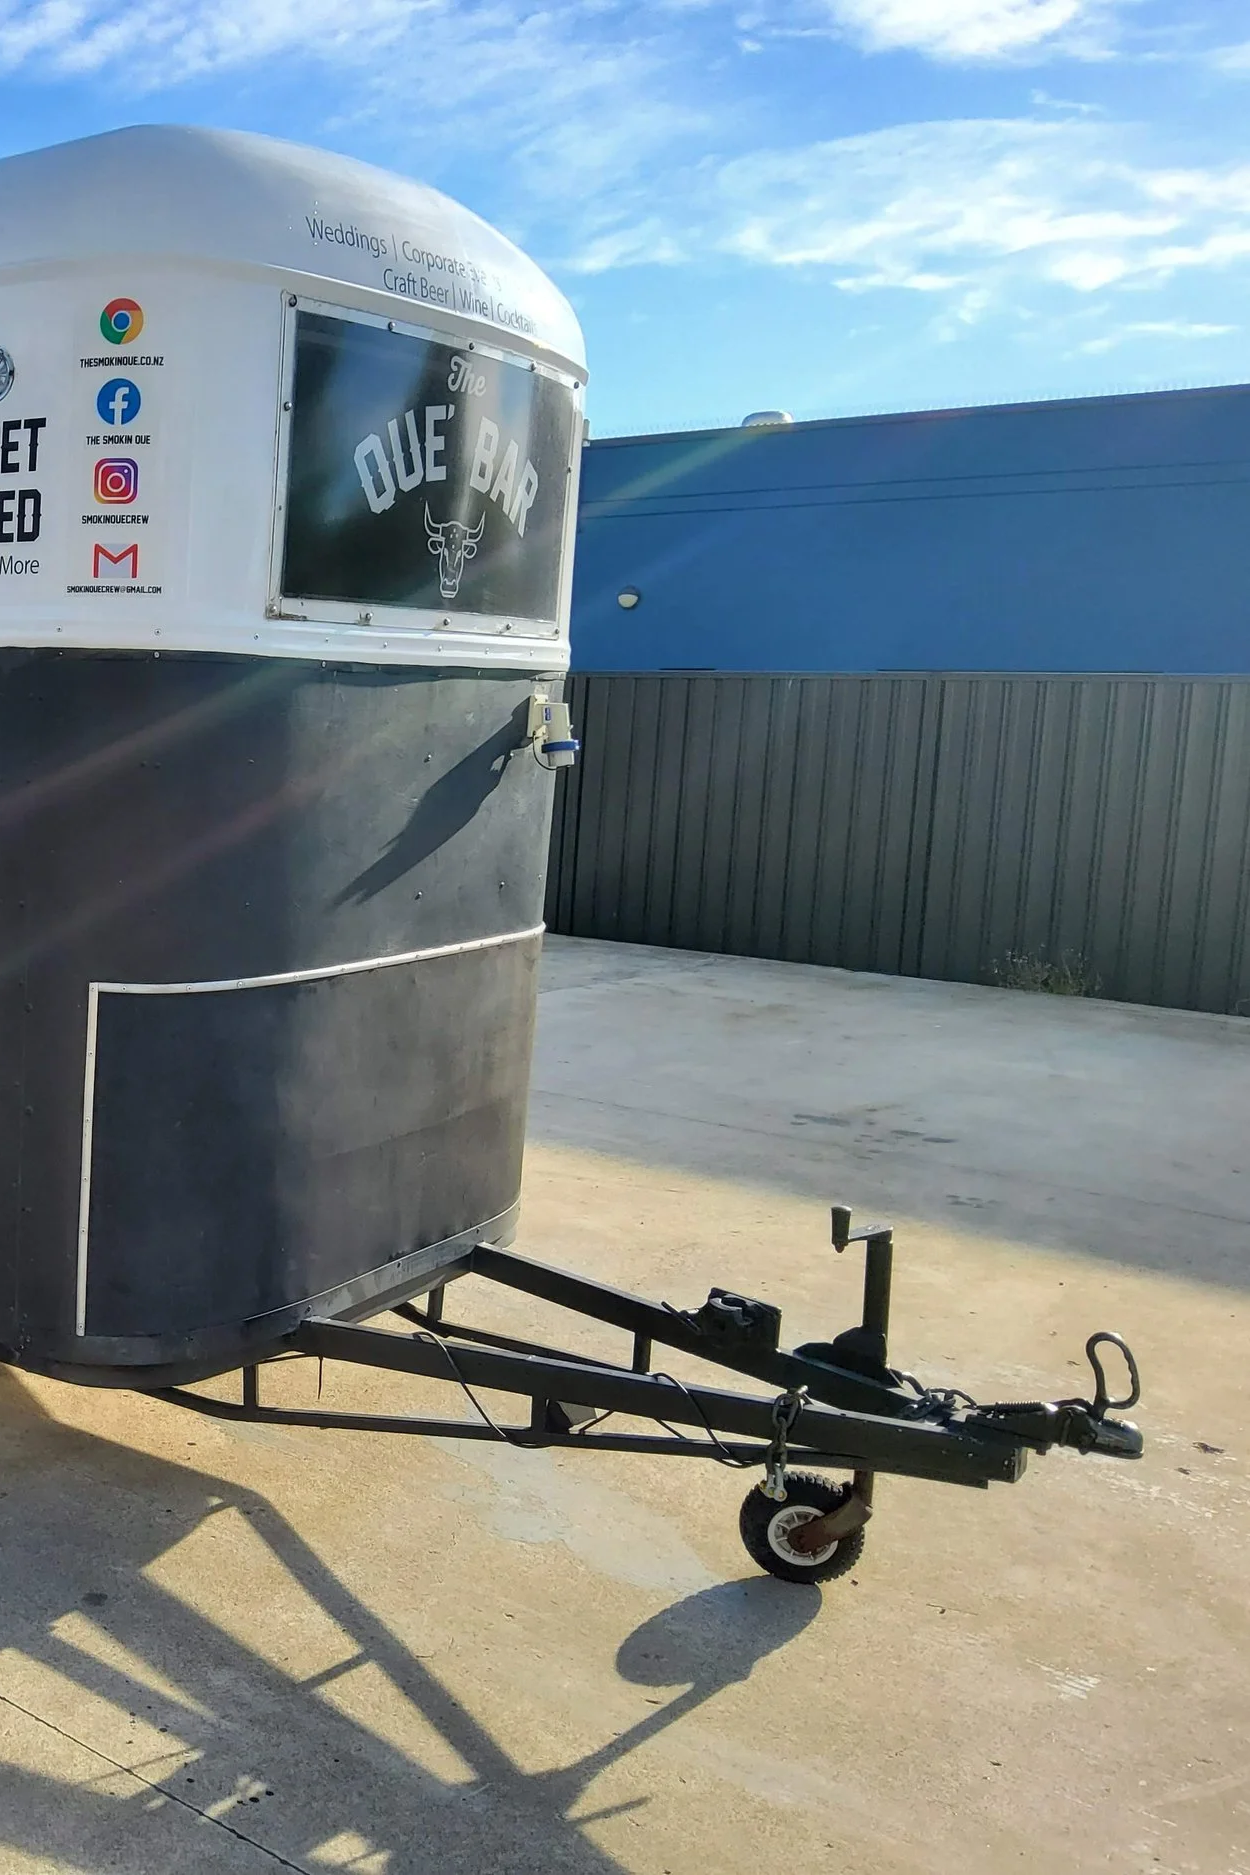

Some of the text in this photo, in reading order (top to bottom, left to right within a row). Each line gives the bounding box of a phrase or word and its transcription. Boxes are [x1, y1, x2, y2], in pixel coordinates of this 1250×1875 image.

[305, 216, 388, 258] Weddings
[401, 240, 465, 278] Corporate
[383, 268, 417, 296] Craft
[420, 276, 449, 303] Beer
[459, 287, 489, 317] Wine
[447, 355, 487, 397] The
[85, 435, 101, 445] THE
[102, 434, 133, 445] SMOKIN
[469, 415, 539, 538] BAR
[0, 555, 40, 576] More
